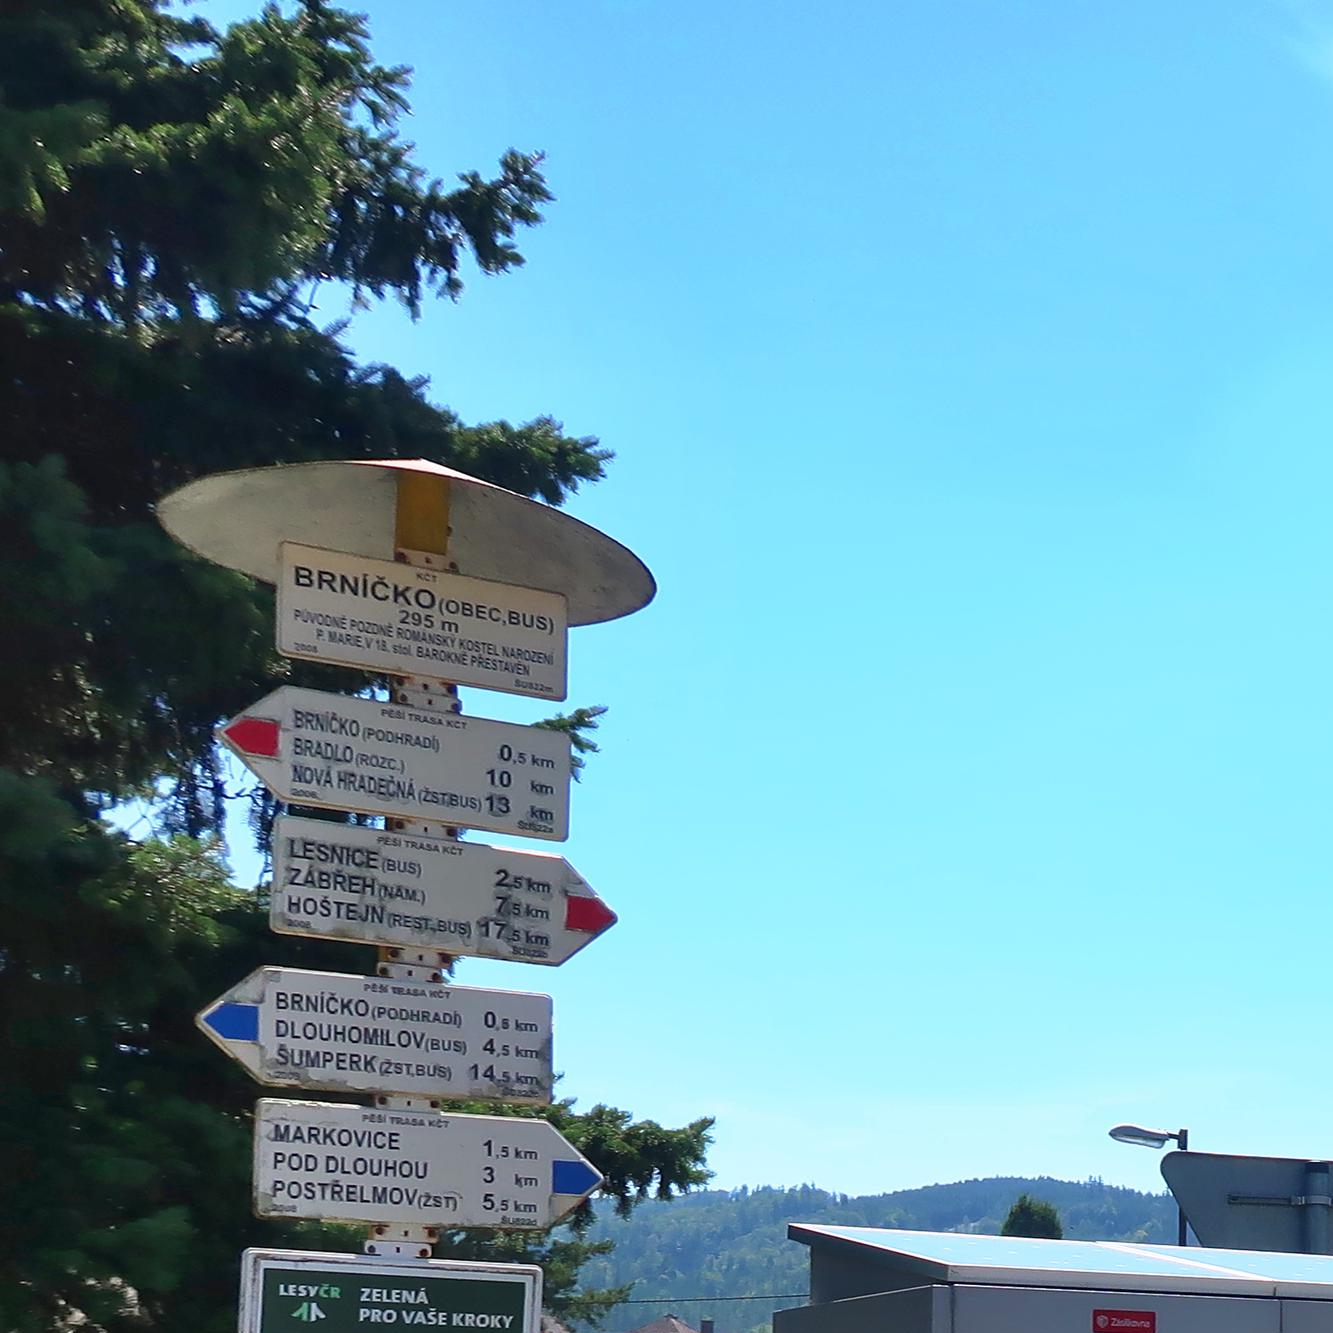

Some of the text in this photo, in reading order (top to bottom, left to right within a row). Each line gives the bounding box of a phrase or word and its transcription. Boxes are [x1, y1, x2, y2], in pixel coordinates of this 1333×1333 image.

[294, 565, 554, 635] BRNÍČKO (OBEC,BUS)
[399, 609, 459, 634] 295 m
[459, 638, 500, 656] KOSTEL
[502, 645, 554, 665] NAROZENÍ
[293, 709, 440, 753] BRNÍČKO (PODHRADÍ)
[408, 712, 442, 725] TRASA
[293, 737, 405, 775] BRADLO (ROZC.)
[499, 744, 555, 769] 0,5 km
[292, 764, 333, 788] NOVÁ
[337, 770, 416, 800] HRADEČNÁ
[486, 769, 553, 795] 10 km
[485, 794, 553, 821] 13 km
[288, 838, 422, 878] LESNICE (BUS)
[405, 840, 440, 853] TRASA
[288, 865, 375, 896] ZÁBŘEH
[527, 877, 551, 893] km
[287, 896, 385, 924] HOŠTEJN
[525, 904, 549, 920] km
[525, 930, 549, 946] km
[391, 987, 427, 998] TRASA
[276, 991, 462, 1028] BRNÍČKO (PODHRADÍ)
[275, 1019, 467, 1056] DLOUHOMILOV (BUS)
[515, 1019, 538, 1032] km
[277, 1043, 378, 1073] ŠUMPERK
[483, 1038, 539, 1059] 4,5 km
[469, 1063, 539, 1086] 14,5 km
[389, 1117, 425, 1127] TRASA
[273, 1124, 400, 1150] MARKOVICE
[483, 1140, 538, 1160] 1,5 km
[274, 1152, 428, 1179] POD DLOUHOU
[483, 1166, 538, 1187] 3 km
[272, 1180, 418, 1206] POSTŘELMOV
[482, 1193, 537, 1213] 5,5 km
[360, 1287, 429, 1305] ZELENÁ
[359, 1308, 514, 1329] PRO VAŠE KROKY
